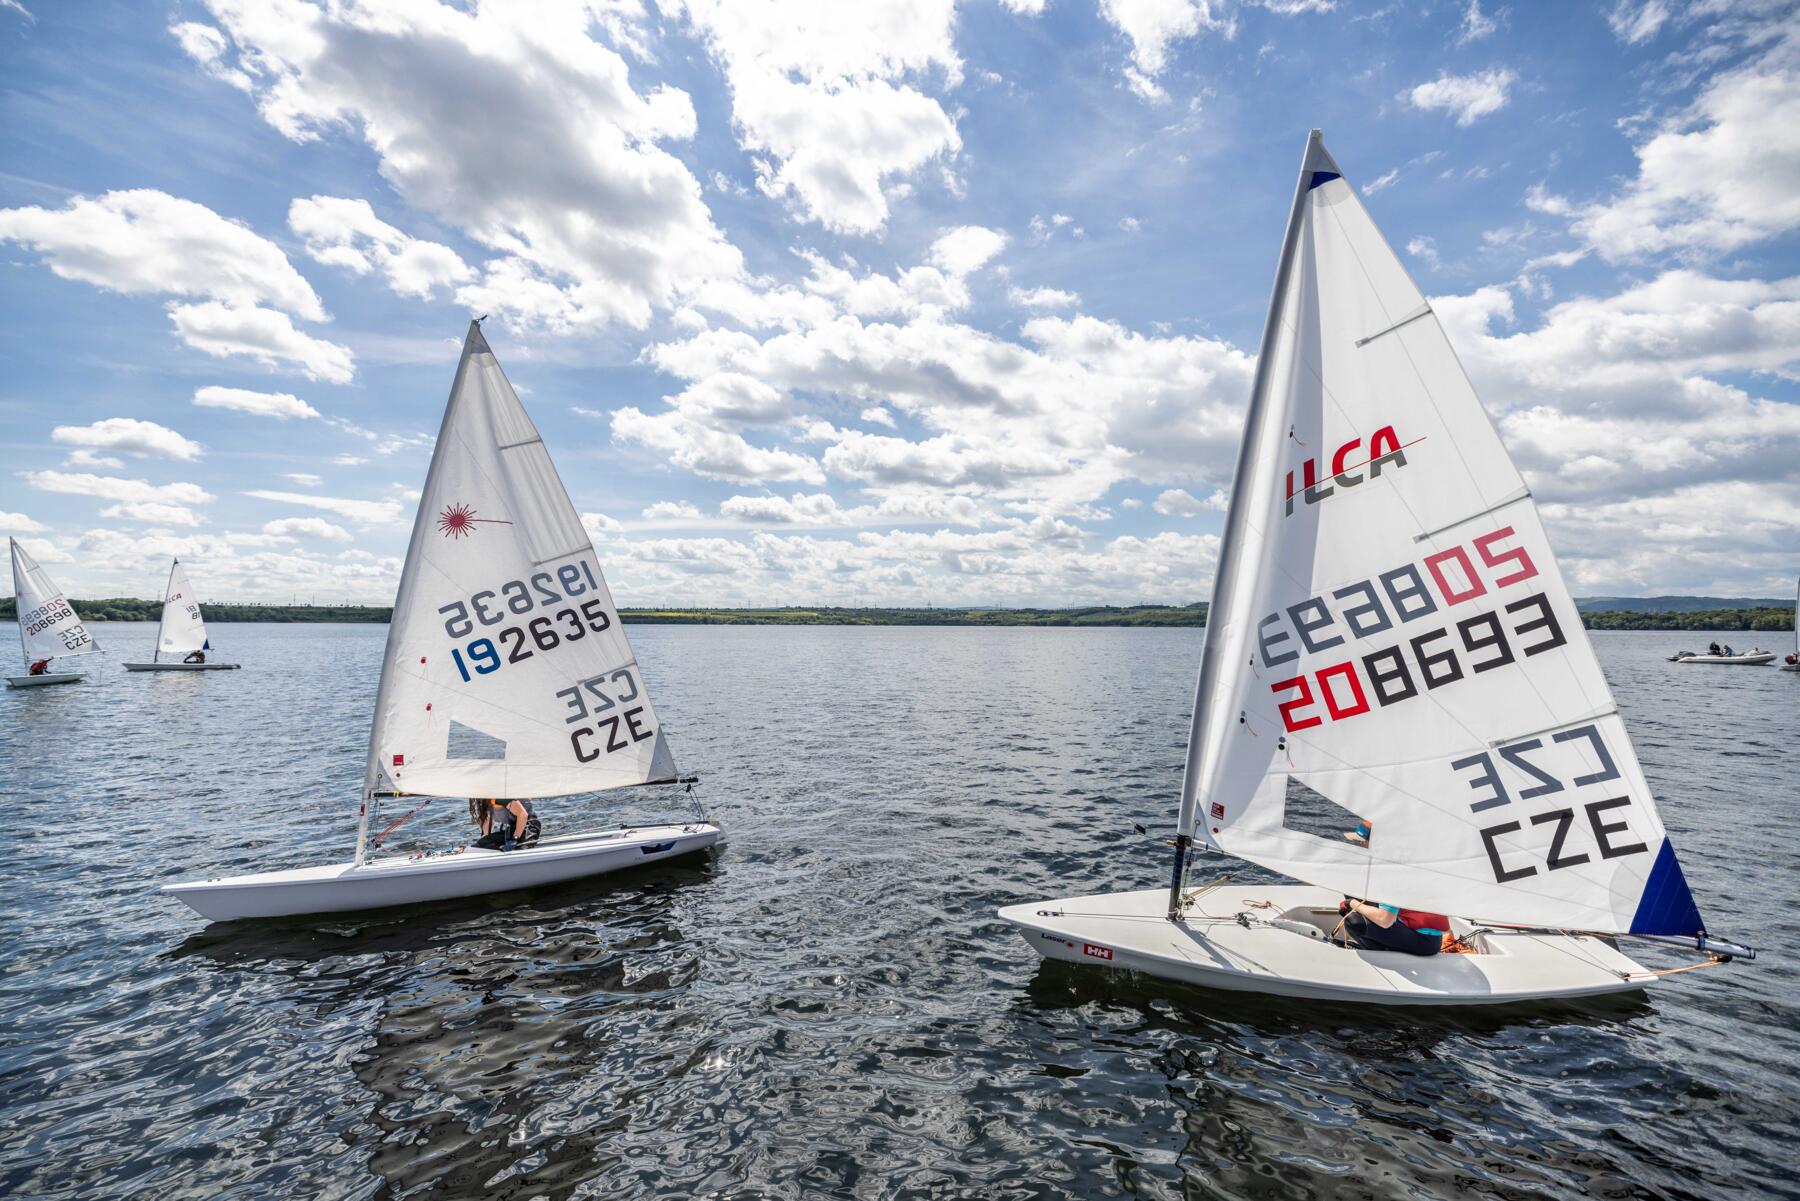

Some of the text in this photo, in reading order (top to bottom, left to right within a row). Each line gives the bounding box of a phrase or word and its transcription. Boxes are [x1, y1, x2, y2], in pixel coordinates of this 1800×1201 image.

[1285, 425, 1408, 517] ILCA
[26, 608, 72, 637] 208698
[64, 634, 91, 651] CZE
[451, 598, 611, 683] 192635
[1270, 592, 1567, 734] 208693
[570, 706, 653, 763] CZE
[1480, 795, 1648, 884] CZE
[1041, 933, 1066, 944] Laser
